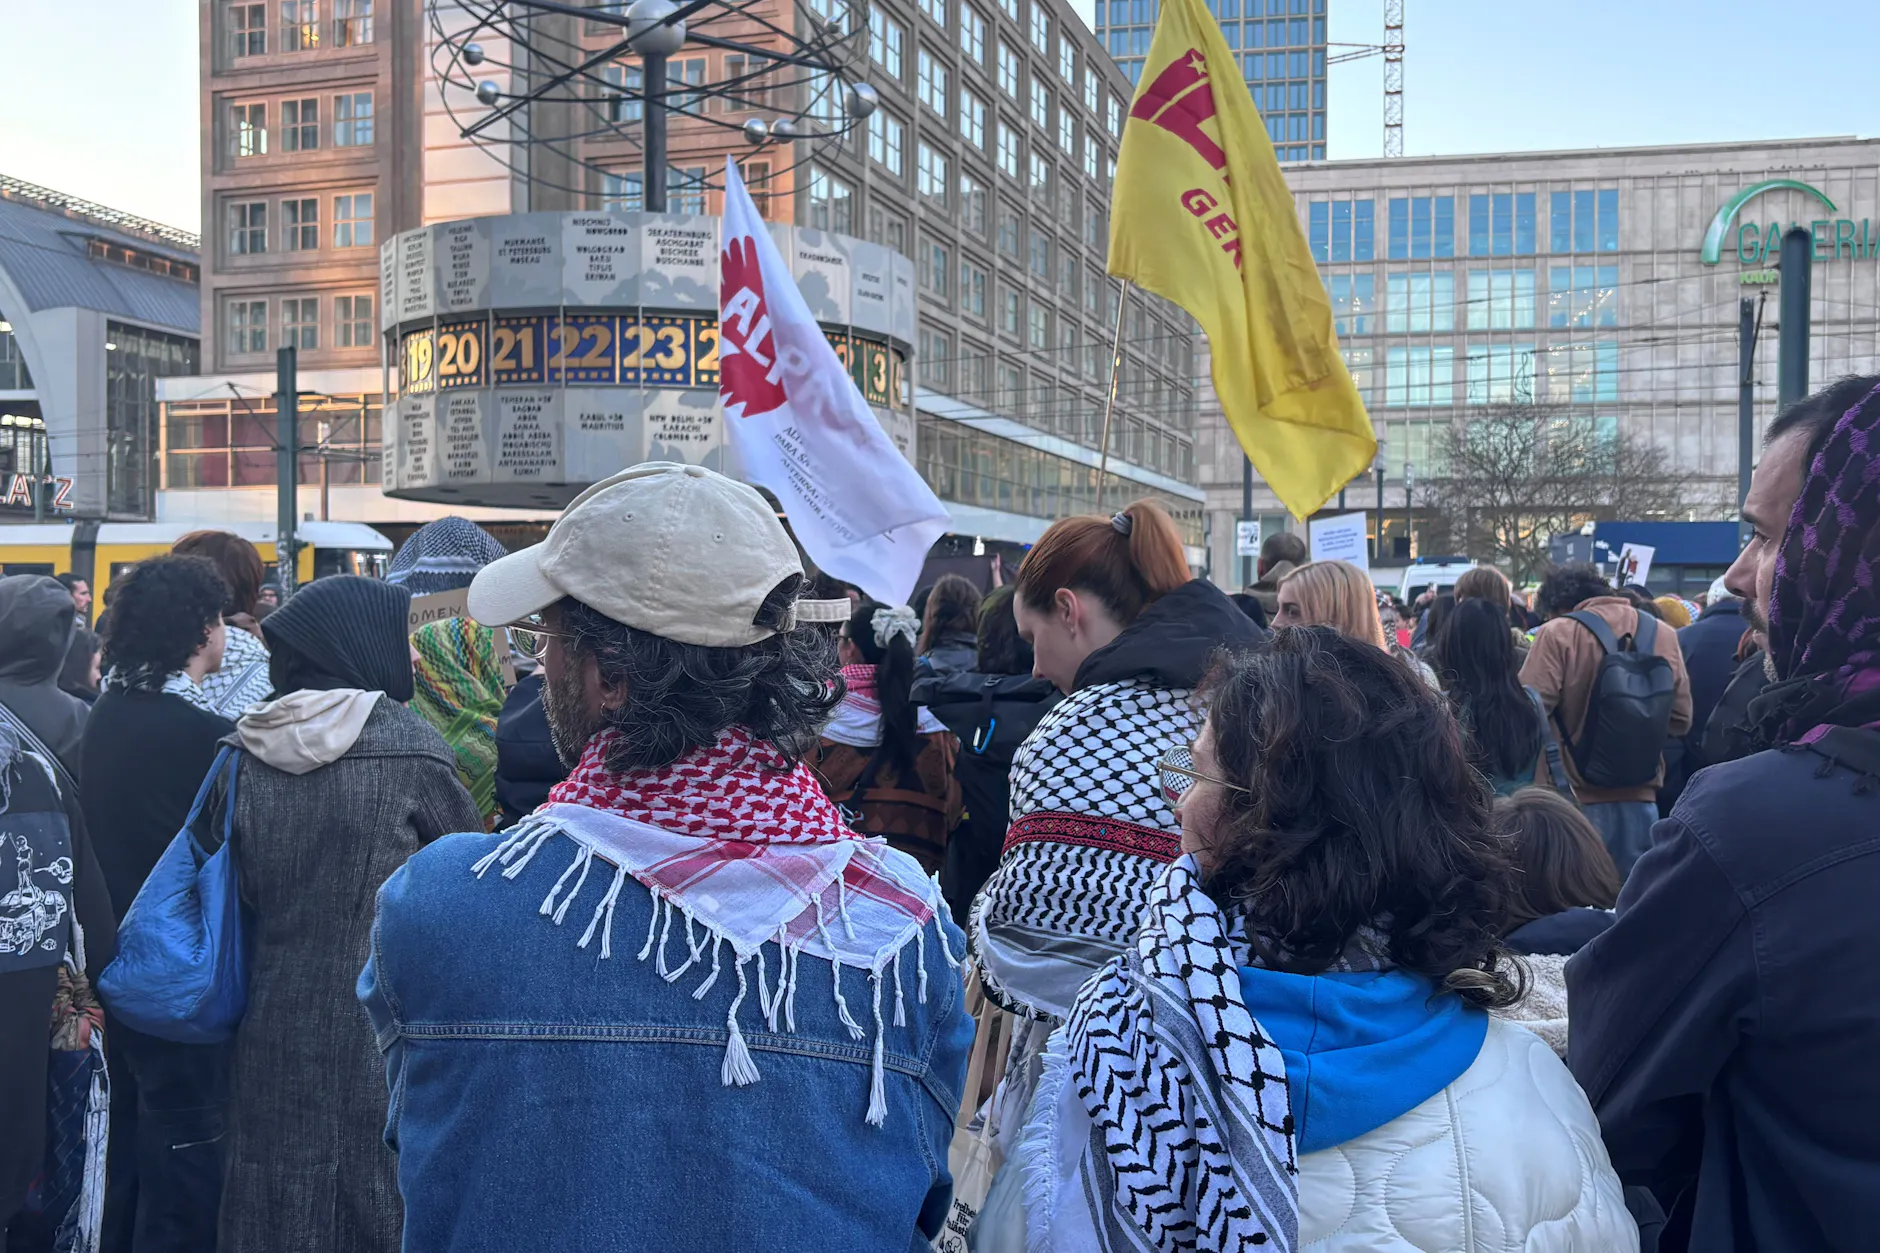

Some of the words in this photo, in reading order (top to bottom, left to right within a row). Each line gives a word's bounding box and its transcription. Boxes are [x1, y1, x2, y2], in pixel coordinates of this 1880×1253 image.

[576, 246, 625, 254] WOLGOGRAD
[1737, 218, 1880, 264] GAERI
[439, 332, 479, 375] 20
[494, 327, 534, 370] 21
[549, 325, 612, 368] 22
[623, 326, 686, 369] 23
[697, 328, 720, 370] 2
[410, 336, 434, 382] 19
[501, 396, 535, 404] TEHERAN
[581, 422, 624, 431] MAURITIUS
[663, 424, 701, 432] KARACHI
[671, 415, 695, 423] DELHI
[653, 433, 690, 441] COLOMBO
[774, 434, 798, 456] PARA
[513, 468, 541, 476] KUWAIT
[0, 474, 74, 509] AZ
[956, 1211, 970, 1226] für
